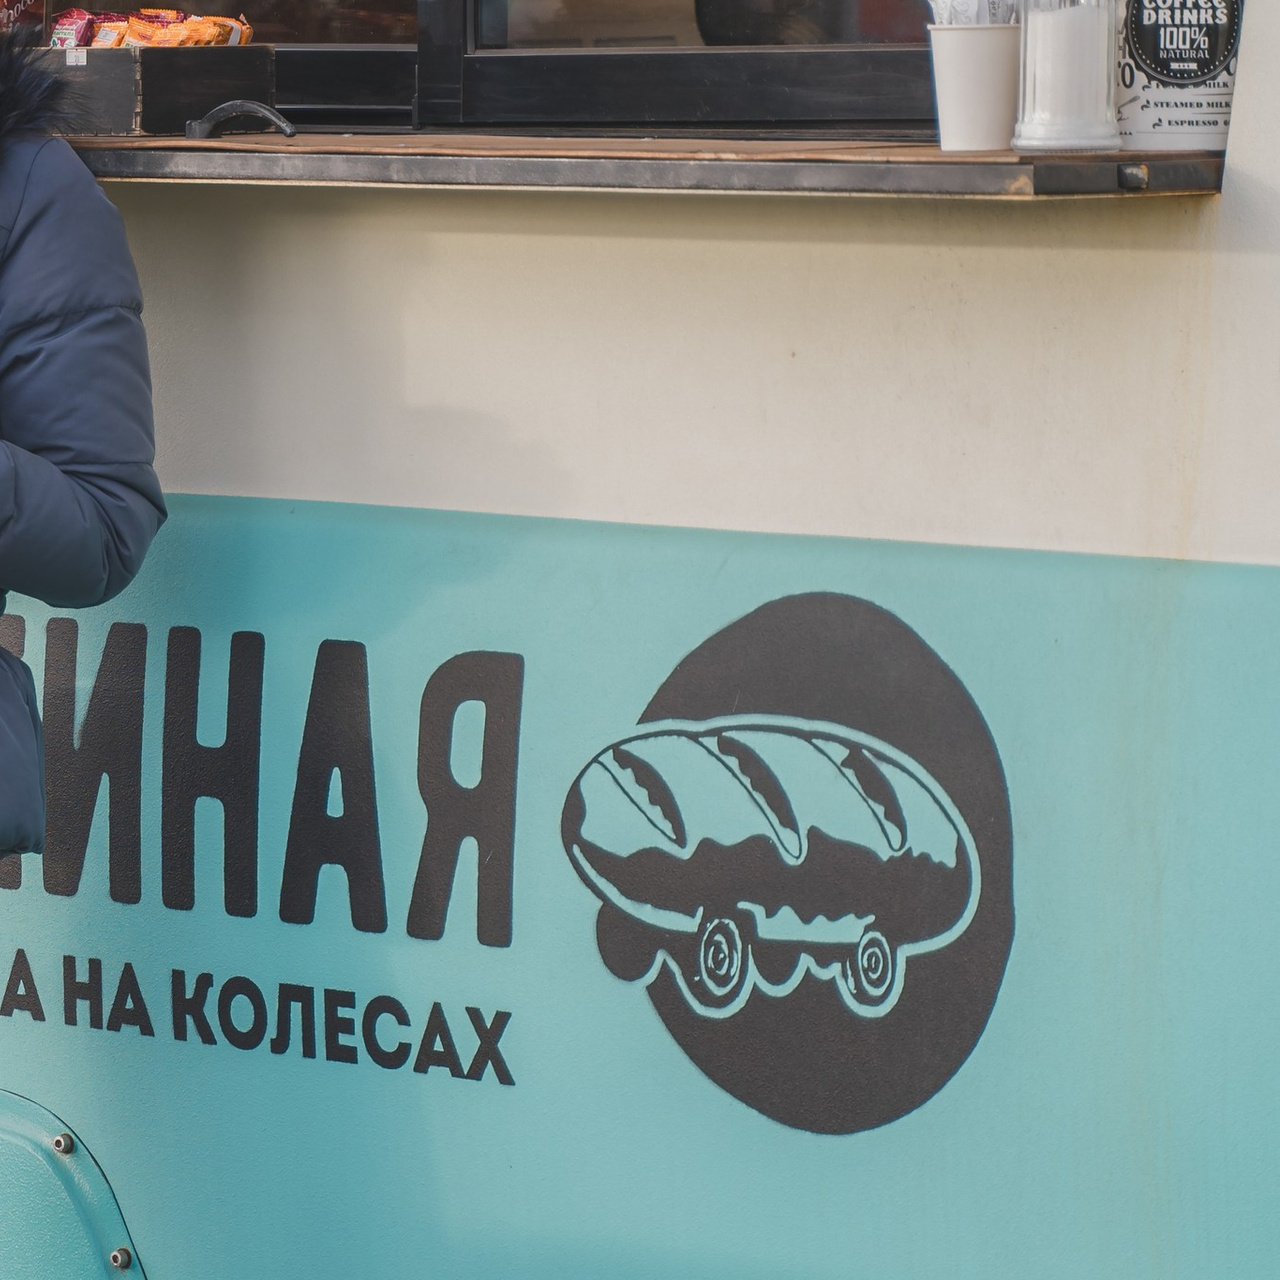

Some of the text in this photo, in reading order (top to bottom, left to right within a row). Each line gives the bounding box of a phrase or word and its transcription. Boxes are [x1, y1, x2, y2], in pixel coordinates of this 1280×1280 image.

[1142, 9, 1228, 25] DRINKS
[1160, 26, 1209, 49] 100%
[1159, 49, 1210, 59] NATURAL
[1153, 101, 1231, 109] STEAMED MILK
[1168, 119, 1219, 127] ESPRESSO
[62, 954, 155, 1038] НА
[170, 968, 517, 1087] КОЛЕСАХ
